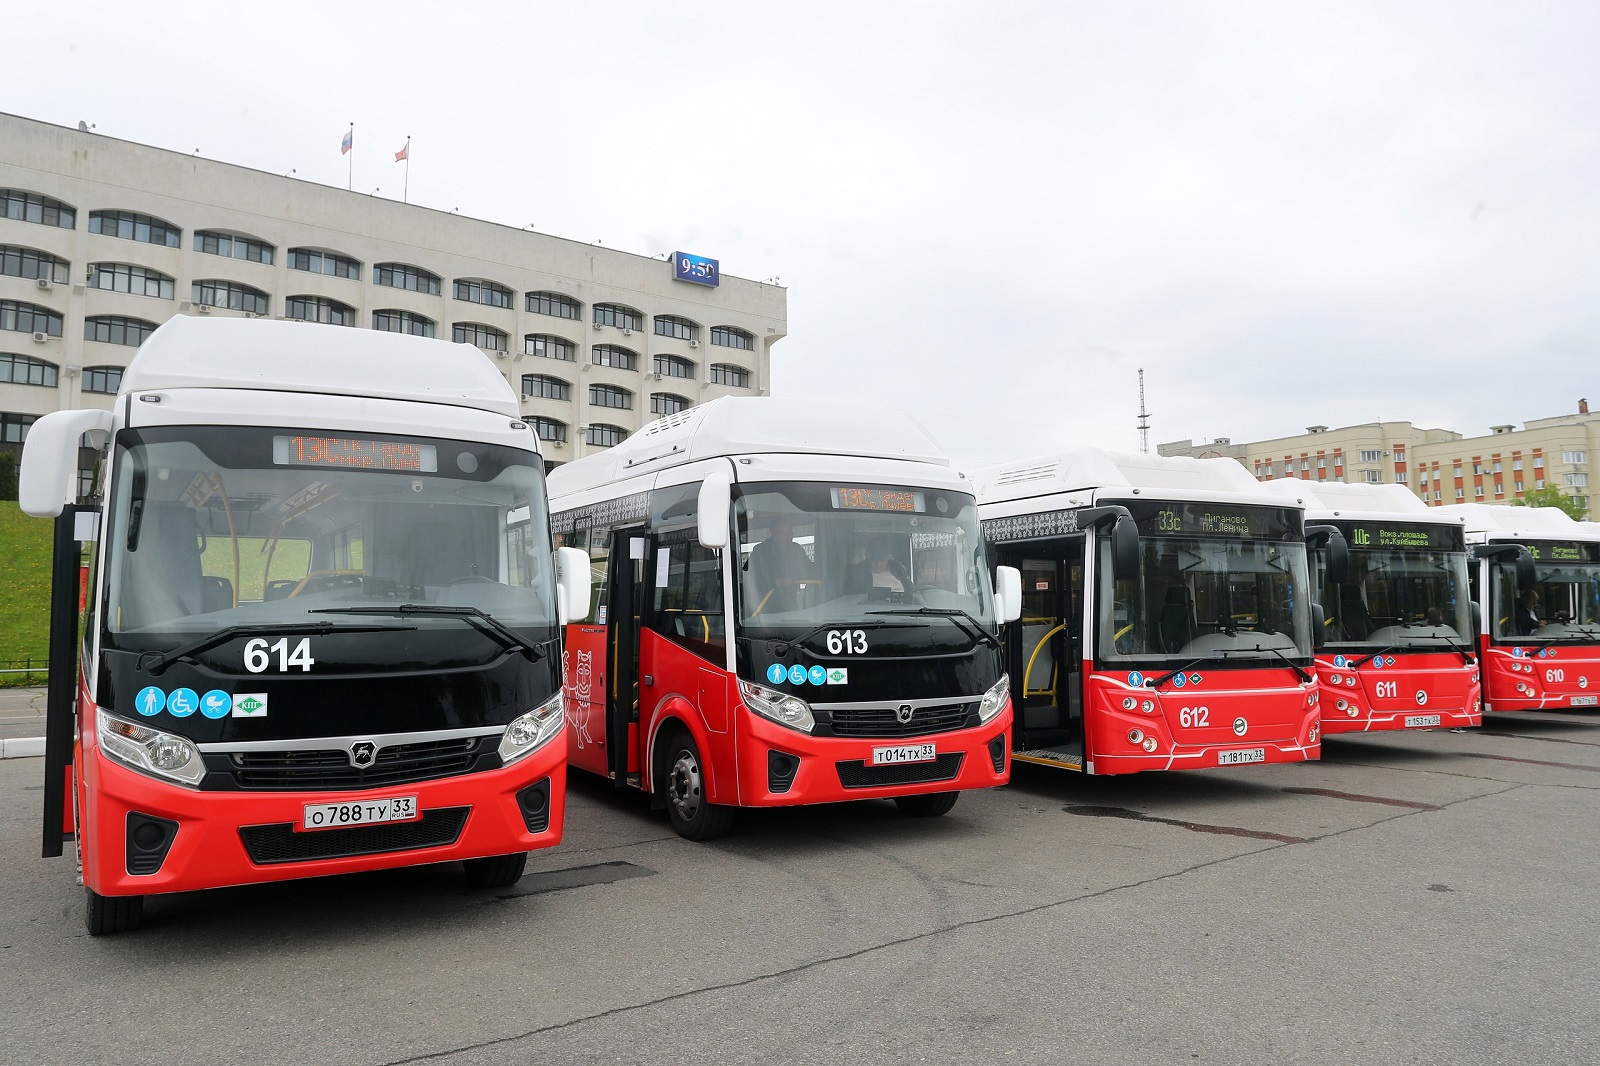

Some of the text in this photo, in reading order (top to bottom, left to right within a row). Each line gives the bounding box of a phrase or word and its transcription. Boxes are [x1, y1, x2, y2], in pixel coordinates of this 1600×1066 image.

[682, 258, 714, 279] 9:59
[1205, 513, 1247, 524] Пиганово
[826, 629, 868, 655] 613
[243, 637, 315, 673] 614
[1546, 668, 1564, 683] 610
[1375, 680, 1397, 698] 611
[1179, 706, 1210, 728] 612
[393, 799, 411, 813] 33
